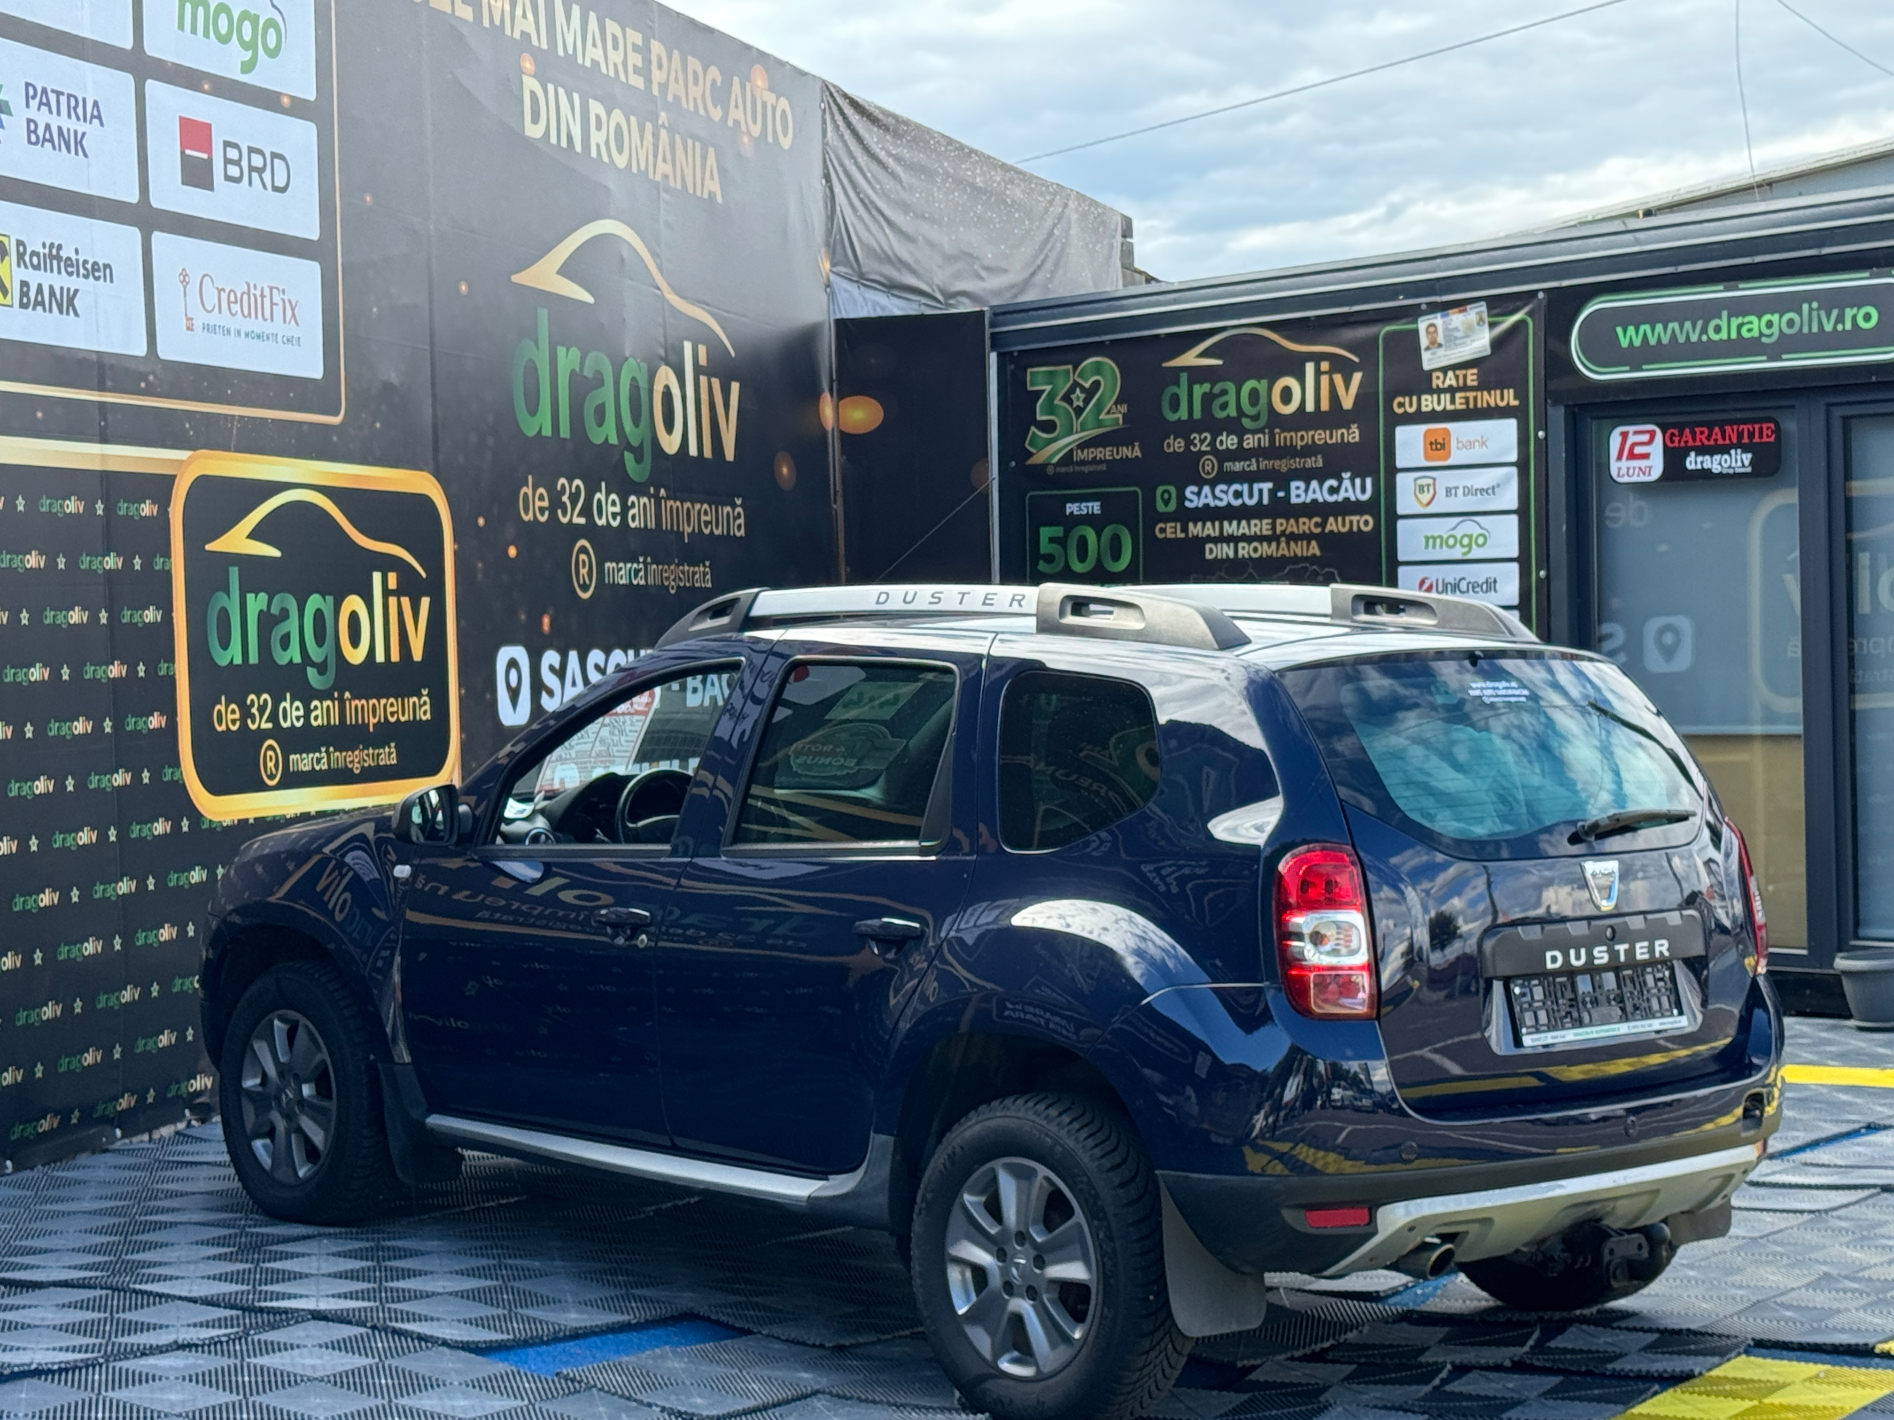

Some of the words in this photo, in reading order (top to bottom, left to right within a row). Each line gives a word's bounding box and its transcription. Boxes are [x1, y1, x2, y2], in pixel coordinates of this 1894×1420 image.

[177, 0, 283, 74] mogo
[555, 0, 645, 90] MARE
[650, 38, 722, 122] PARC
[727, 76, 794, 150] AUTO
[24, 81, 105, 128] PATRIA
[26, 118, 89, 159] BANK
[522, 73, 582, 153] DIN
[588, 98, 723, 204] ROMÂNIA
[222, 139, 291, 194] BRD
[15, 238, 114, 284] Raiffeisen
[19, 280, 81, 318] BANK
[199, 272, 300, 327] CreditFix
[1615, 301, 1878, 349] www.dragoliv.ro
[1431, 368, 1479, 389] RATE
[511, 307, 740, 483] dragoliv
[1025, 356, 1121, 457] 32
[1161, 361, 1363, 429] dragoliv
[1392, 396, 1418, 414] CU
[1420, 388, 1520, 412] BULETINUL
[1164, 434, 1186, 453] de
[1189, 432, 1212, 451] 32
[1216, 430, 1238, 450] de
[1243, 427, 1269, 448] ani
[1274, 424, 1360, 450] împreună
[1428, 436, 1446, 452] tbi
[1456, 435, 1489, 452] bank
[1615, 429, 1657, 462] 12
[1664, 422, 1776, 447] GARANTIE
[1223, 458, 1258, 473] marcă
[1616, 465, 1653, 479] LUNI
[1685, 448, 1753, 473] dragoliv
[1184, 482, 1273, 509] SASCUT
[1289, 472, 1373, 505] BACĂU
[1445, 486, 1460, 498] BT
[39, 495, 84, 517] dragoliv
[117, 499, 158, 520] dragoliv
[519, 474, 549, 523] de
[556, 477, 587, 525] 32
[593, 481, 622, 528] de
[628, 486, 656, 530] ani
[661, 489, 746, 543] împreună
[1066, 501, 1102, 516] PESTE
[1154, 521, 1186, 539] CEL
[1188, 520, 1221, 538] MAI
[1223, 518, 1272, 538] MARE
[1275, 516, 1322, 535] PARC
[1325, 514, 1374, 533] AUTO
[1037, 523, 1133, 574] 500
[1204, 541, 1235, 560] DIN
[1237, 537, 1321, 559] ROMÂNIA
[1423, 529, 1488, 557] mogo
[79, 552, 124, 573] dragoliv
[604, 556, 646, 586] marcă
[646, 559, 712, 594] înregistrată
[875, 591, 1026, 608] DUSTER
[1435, 576, 1498, 595] UniCredit
[43, 606, 89, 628] dragoliv
[121, 606, 162, 627] dragoliv
[207, 566, 430, 690] dragoliv
[3, 662, 50, 685] dragoliv
[83, 660, 127, 682] dragoliv
[47, 716, 93, 738] dragoliv
[124, 712, 167, 733] dragoliv
[213, 695, 241, 732] de
[246, 693, 273, 731] 32
[279, 692, 305, 728] de
[310, 691, 340, 727] ani
[344, 688, 431, 733] împreună
[289, 747, 329, 772] marcă
[329, 742, 397, 774] înregistrată
[8, 775, 55, 799] dragoliv
[87, 768, 132, 791] dragoliv
[52, 826, 98, 850] dragoliv
[129, 817, 172, 840] dragoliv
[12, 887, 60, 913] dragoliv
[93, 876, 137, 900] dragoliv
[167, 866, 208, 889] dragoliv
[1545, 939, 1670, 969] DUSTER
